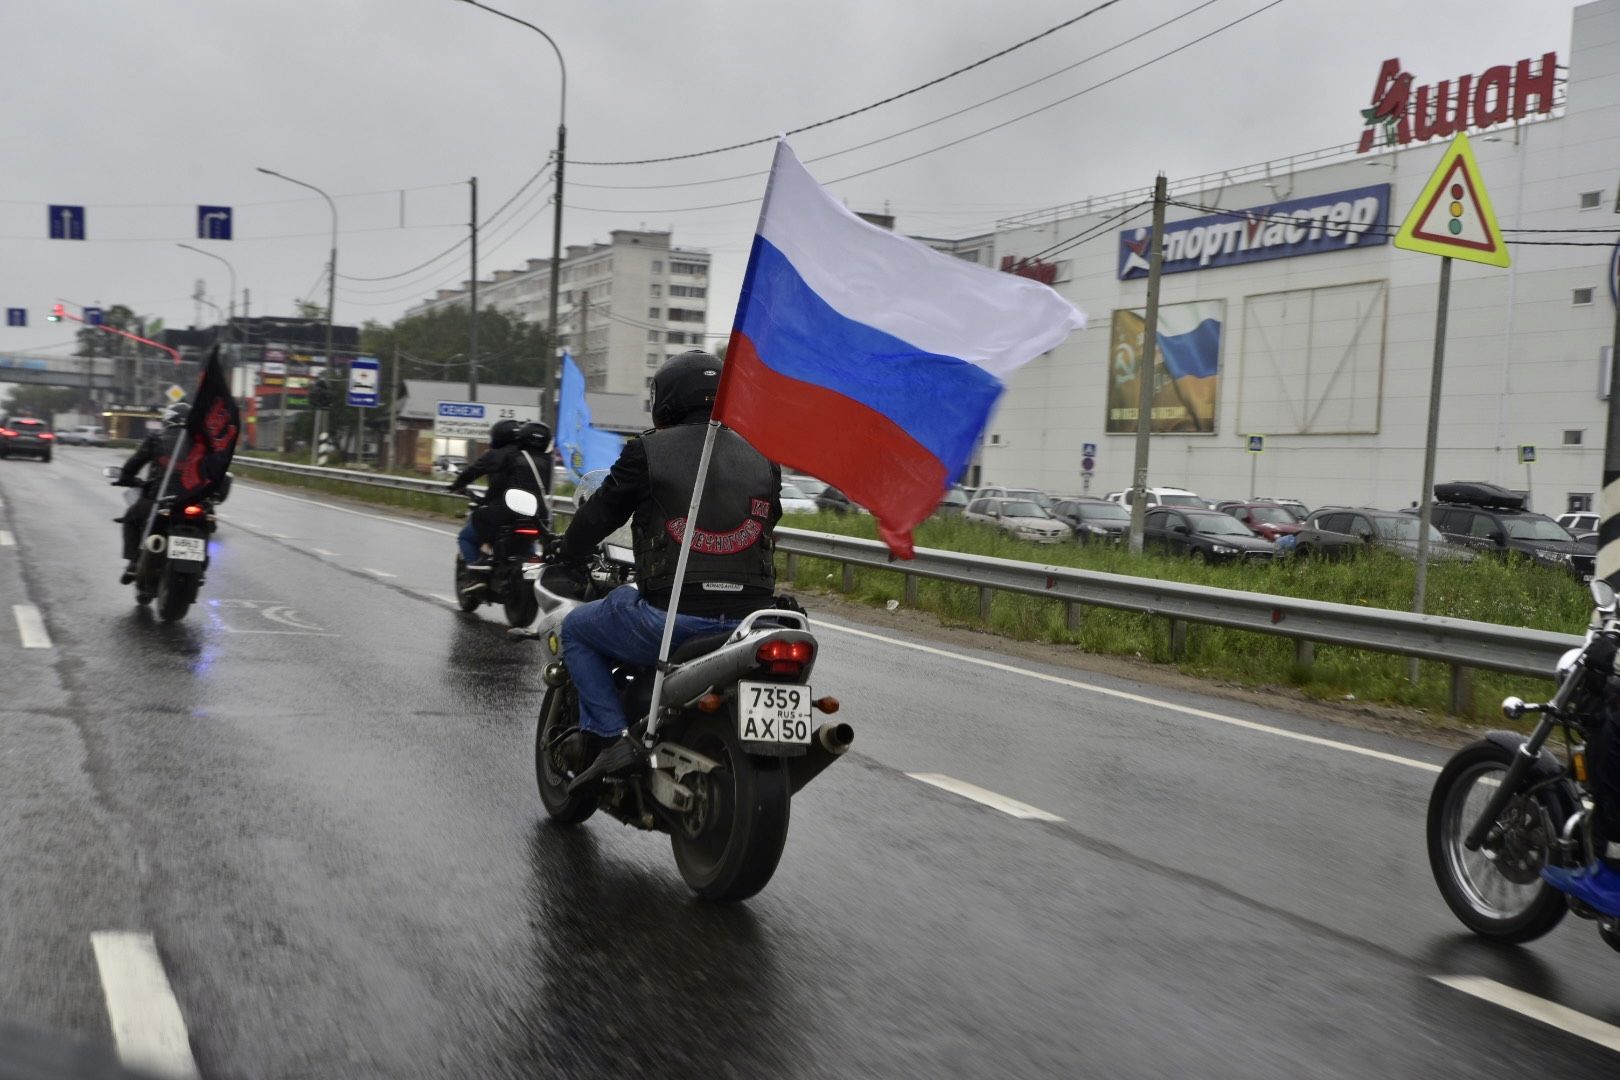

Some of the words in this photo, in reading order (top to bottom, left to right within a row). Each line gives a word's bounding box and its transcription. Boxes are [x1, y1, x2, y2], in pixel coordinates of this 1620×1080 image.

[441, 404, 481, 416] СЕНЕЖ
[750, 687, 801, 710] 7359
[777, 710, 796, 719] RUS
[782, 720, 807, 740] 50
